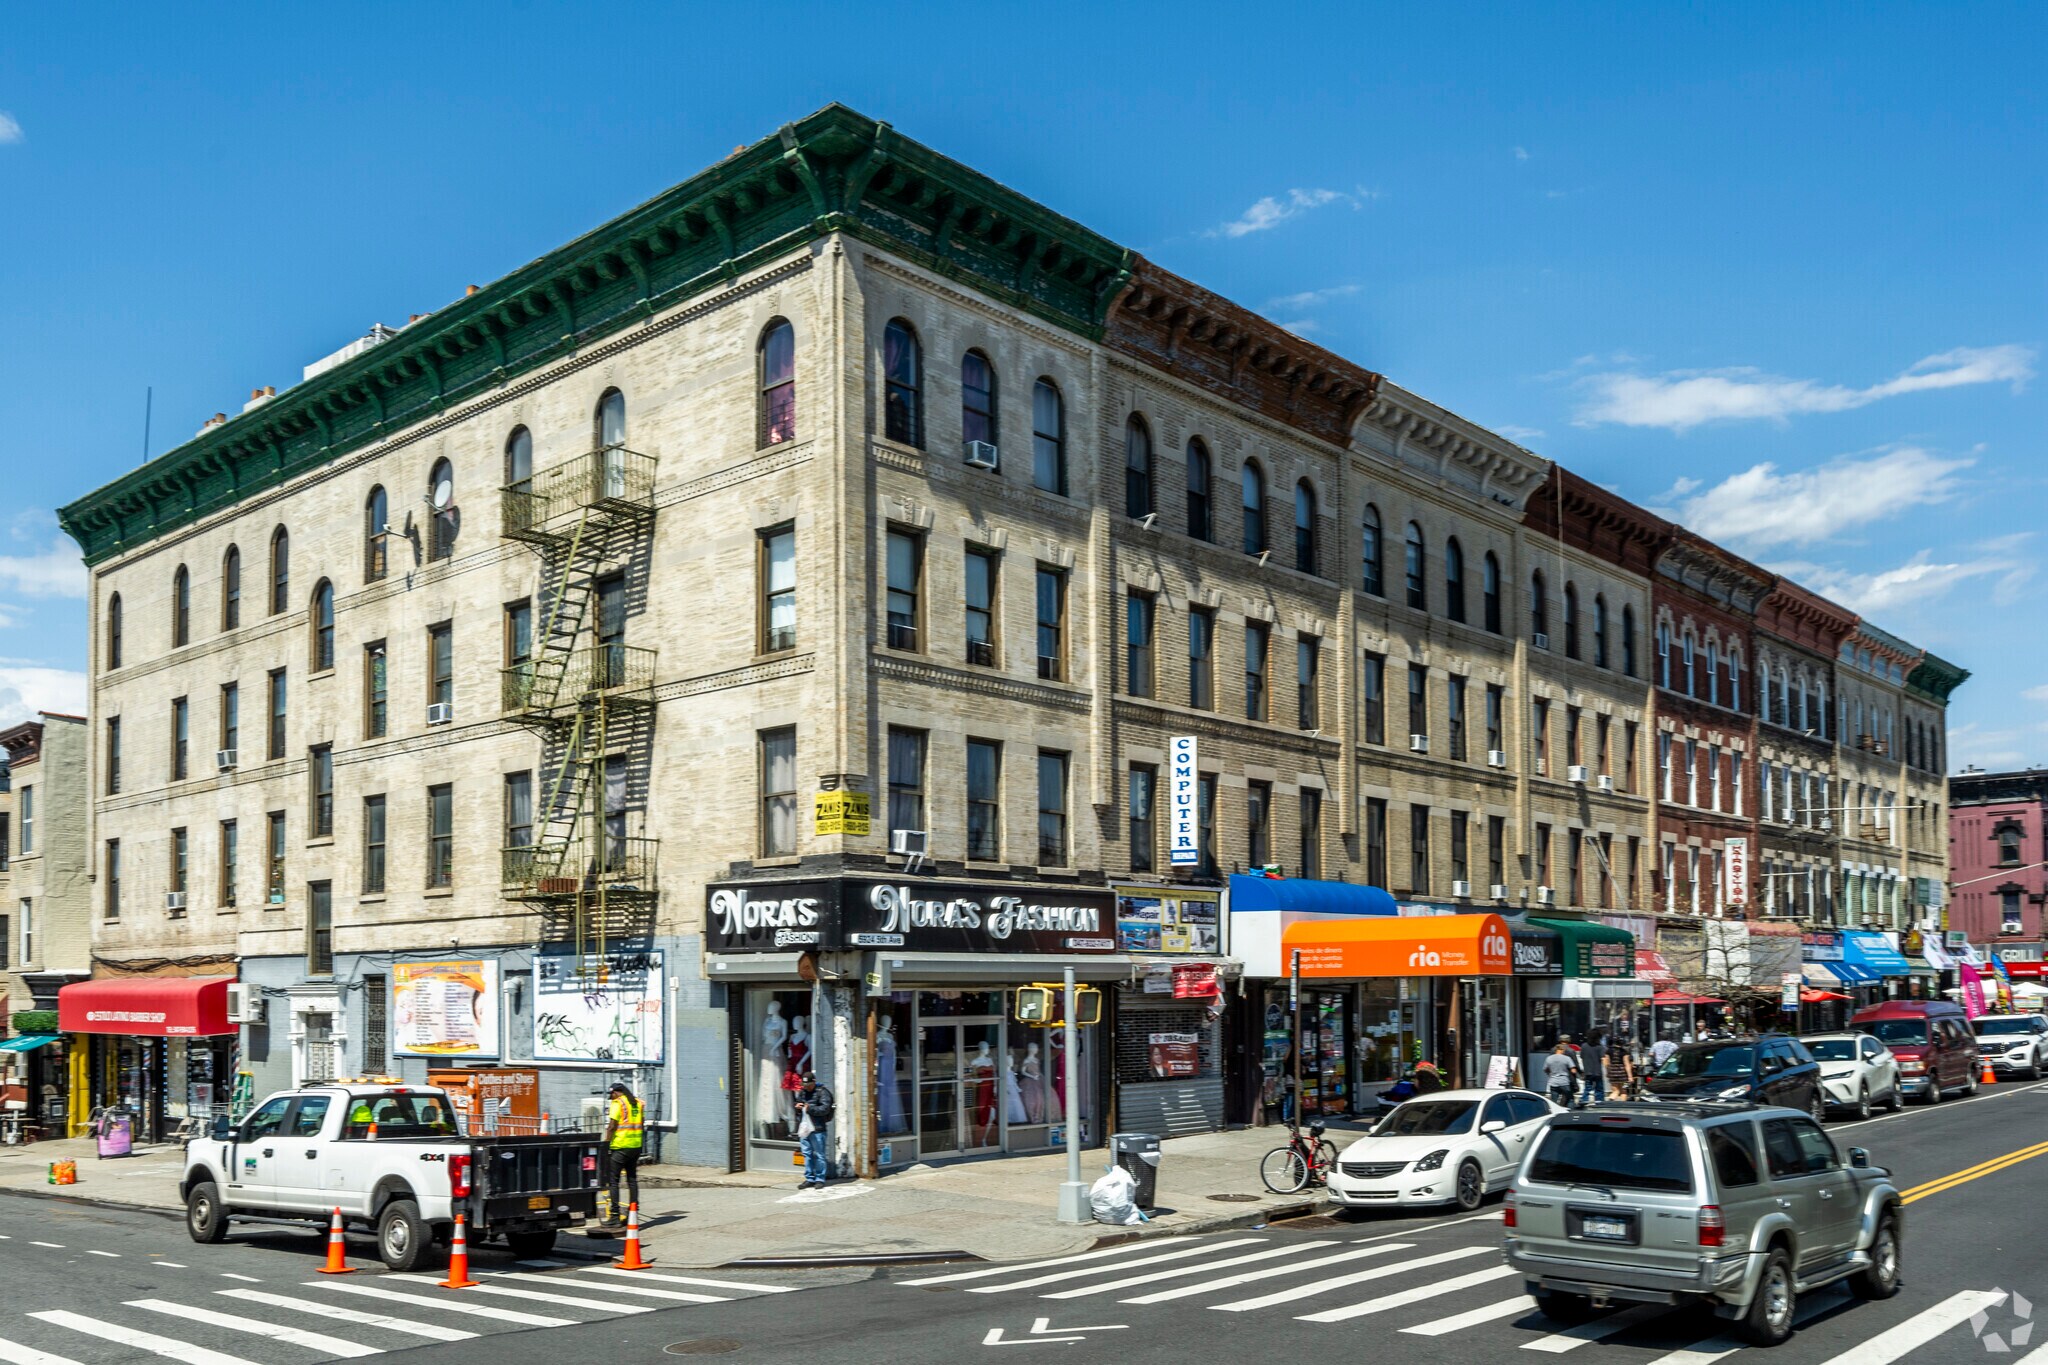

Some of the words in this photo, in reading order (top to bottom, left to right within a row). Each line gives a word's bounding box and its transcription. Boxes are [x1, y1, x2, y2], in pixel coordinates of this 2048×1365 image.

[1176, 739, 1192, 847] COMPUTER
[987, 896, 1100, 939] FASHION
[774, 928, 820, 947] FASHION
[1483, 924, 1507, 956] ria
[1409, 944, 1440, 967] ria
[1442, 951, 1466, 960] Money
[1442, 959, 1470, 967] Transfer
[2000, 949, 2036, 962] GRILL
[478, 1073, 502, 1085] Clothes
[503, 1073, 515, 1085] and
[516, 1072, 535, 1084] Shoes
